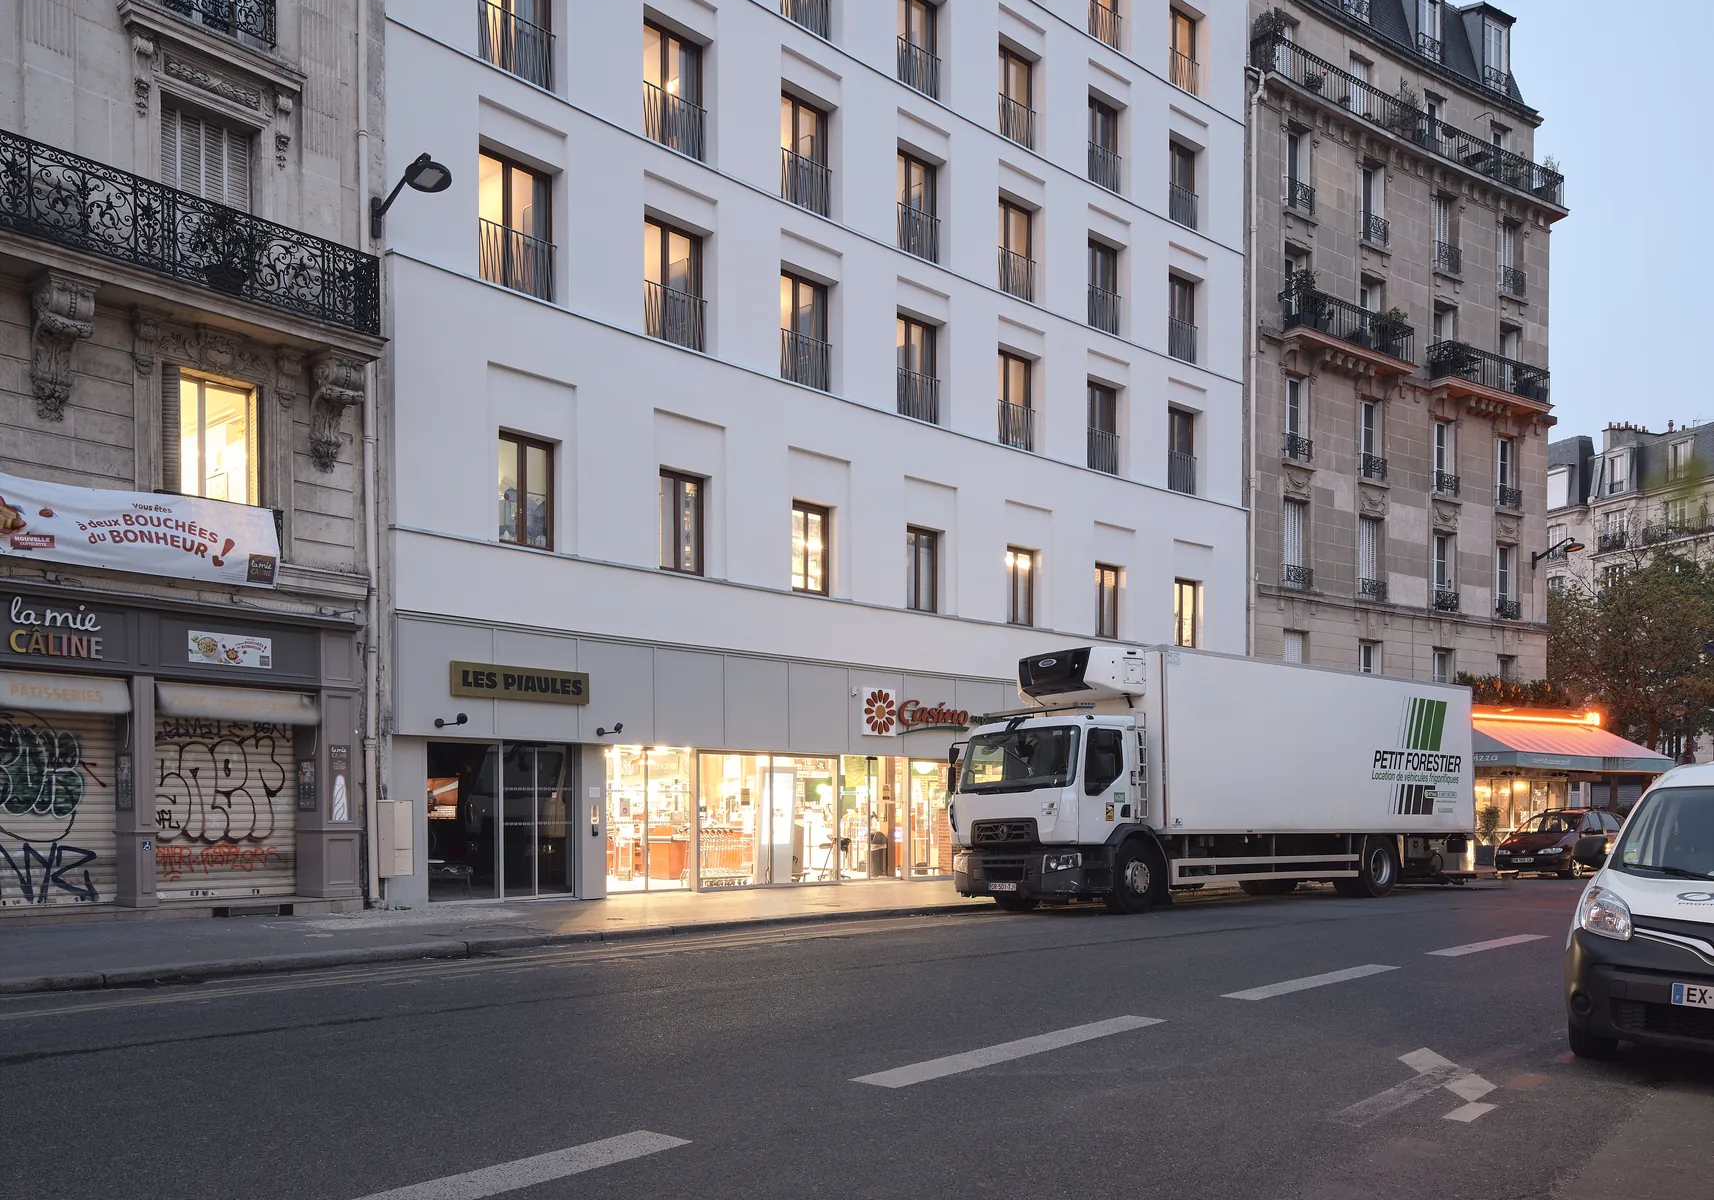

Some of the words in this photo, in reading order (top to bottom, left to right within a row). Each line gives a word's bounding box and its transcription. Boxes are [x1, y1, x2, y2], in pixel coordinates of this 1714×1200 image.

[76, 520, 87, 531] à
[88, 518, 121, 529] deux
[122, 513, 219, 544] BOUCHÉES
[88, 532, 106, 545] du
[108, 529, 209, 559] BONHEUR
[10, 596, 42, 625] la
[44, 604, 102, 632] mie
[9, 626, 103, 660] CÂLINE
[461, 669, 498, 690] LES
[502, 672, 584, 696] PIAULES
[899, 699, 969, 727] Casino
[1371, 769, 1395, 781] Location
[1396, 772, 1403, 782] de
[1372, 749, 1405, 770] PETIT
[1405, 752, 1462, 773] FORESTIER
